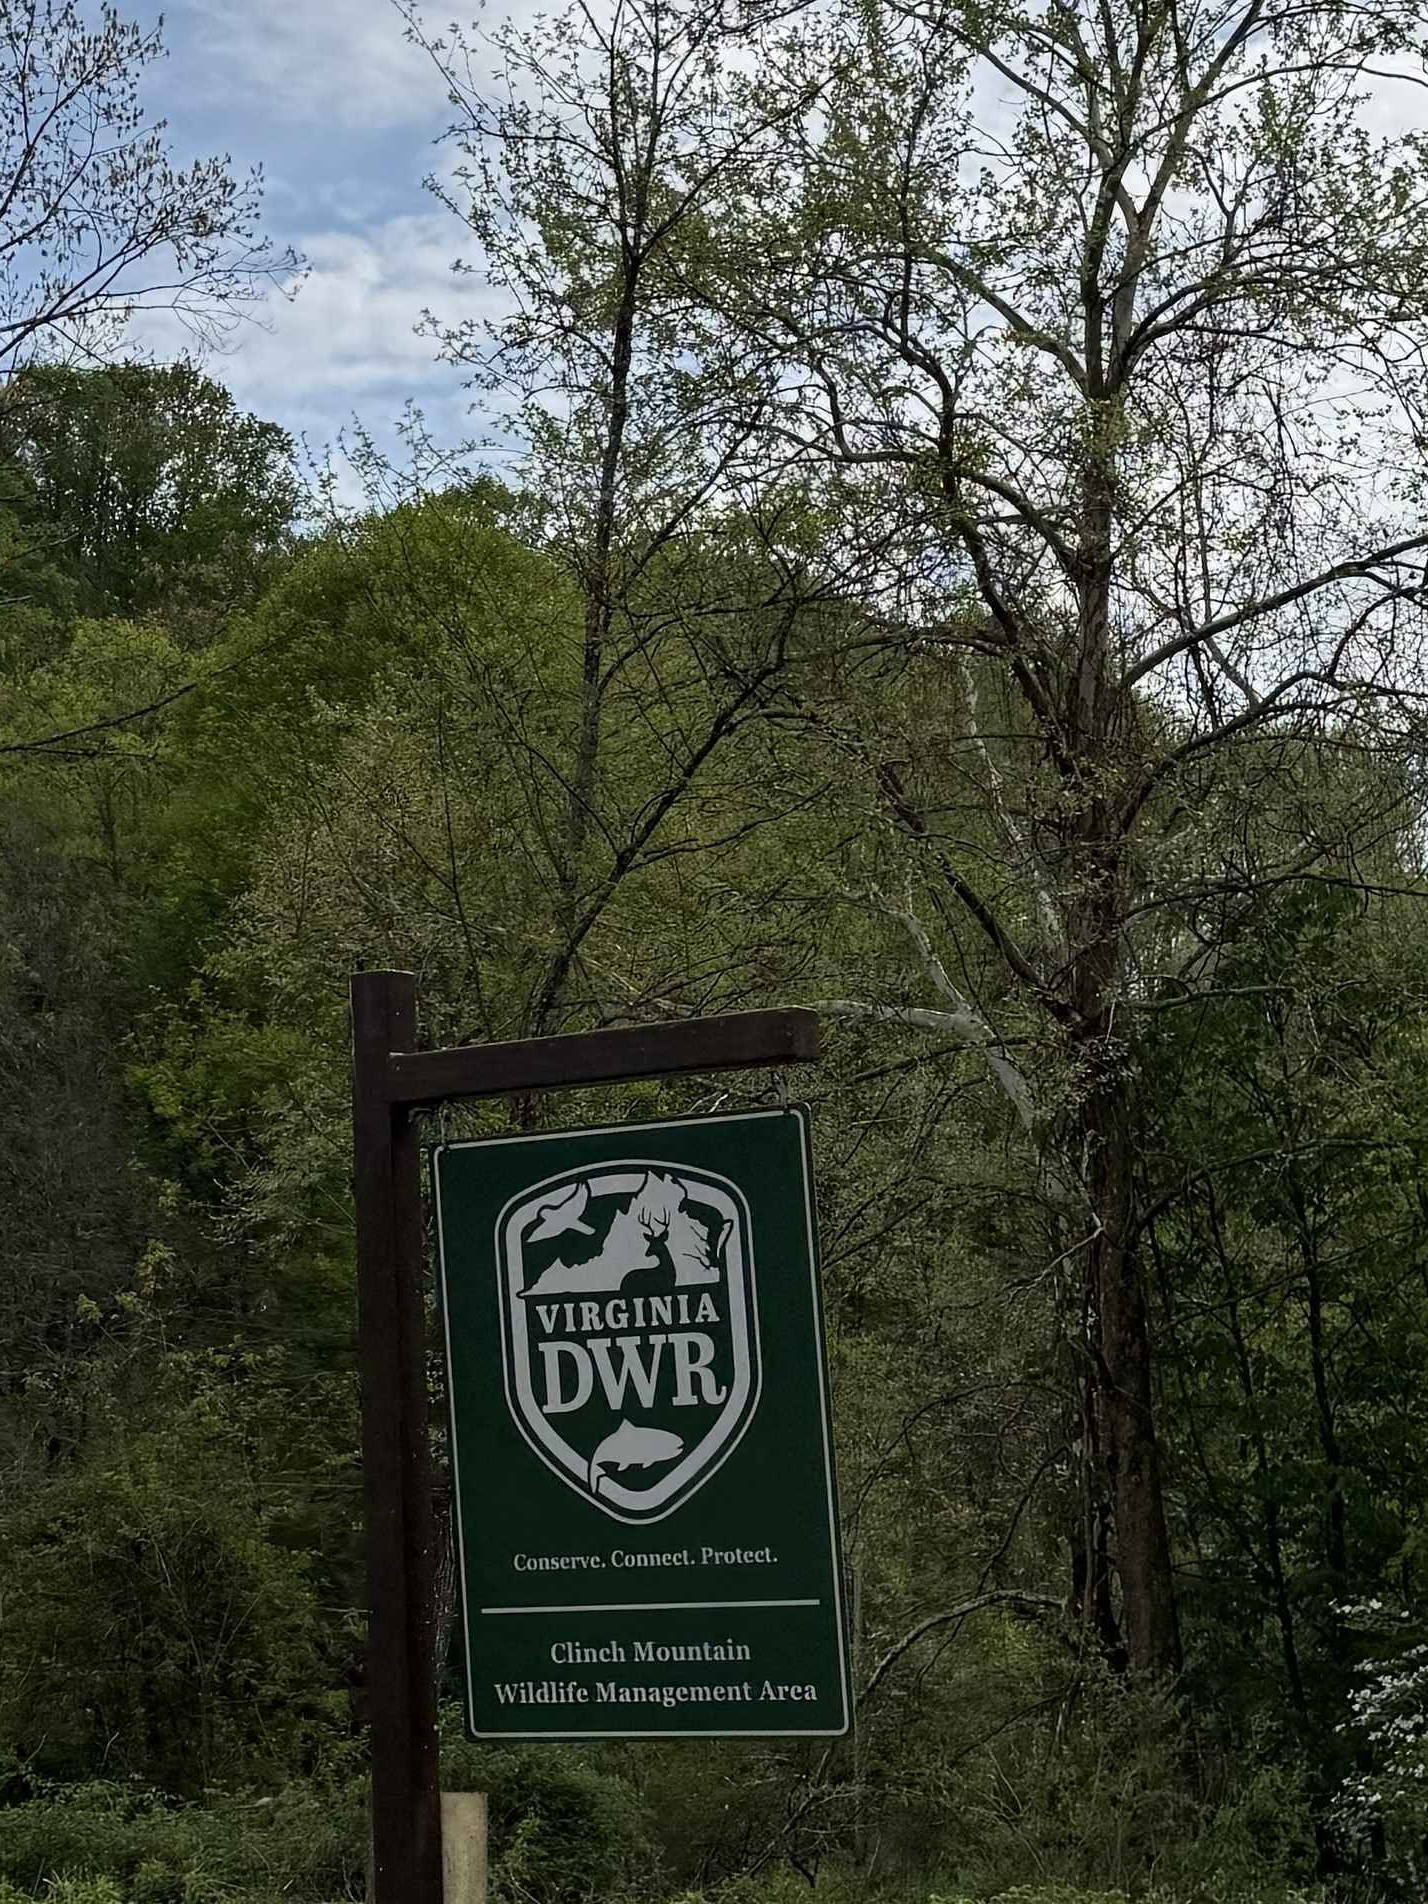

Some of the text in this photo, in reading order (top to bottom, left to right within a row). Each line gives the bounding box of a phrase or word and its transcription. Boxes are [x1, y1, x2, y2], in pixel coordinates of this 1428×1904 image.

[535, 1292, 720, 1334] VIRGINIA
[538, 1331, 727, 1414] DWR
[513, 1546, 778, 1572] Conserve. Connect. Protect.
[550, 1638, 751, 1664] Clinch Mountain
[494, 1680, 818, 1708] Wildlife Management Area
